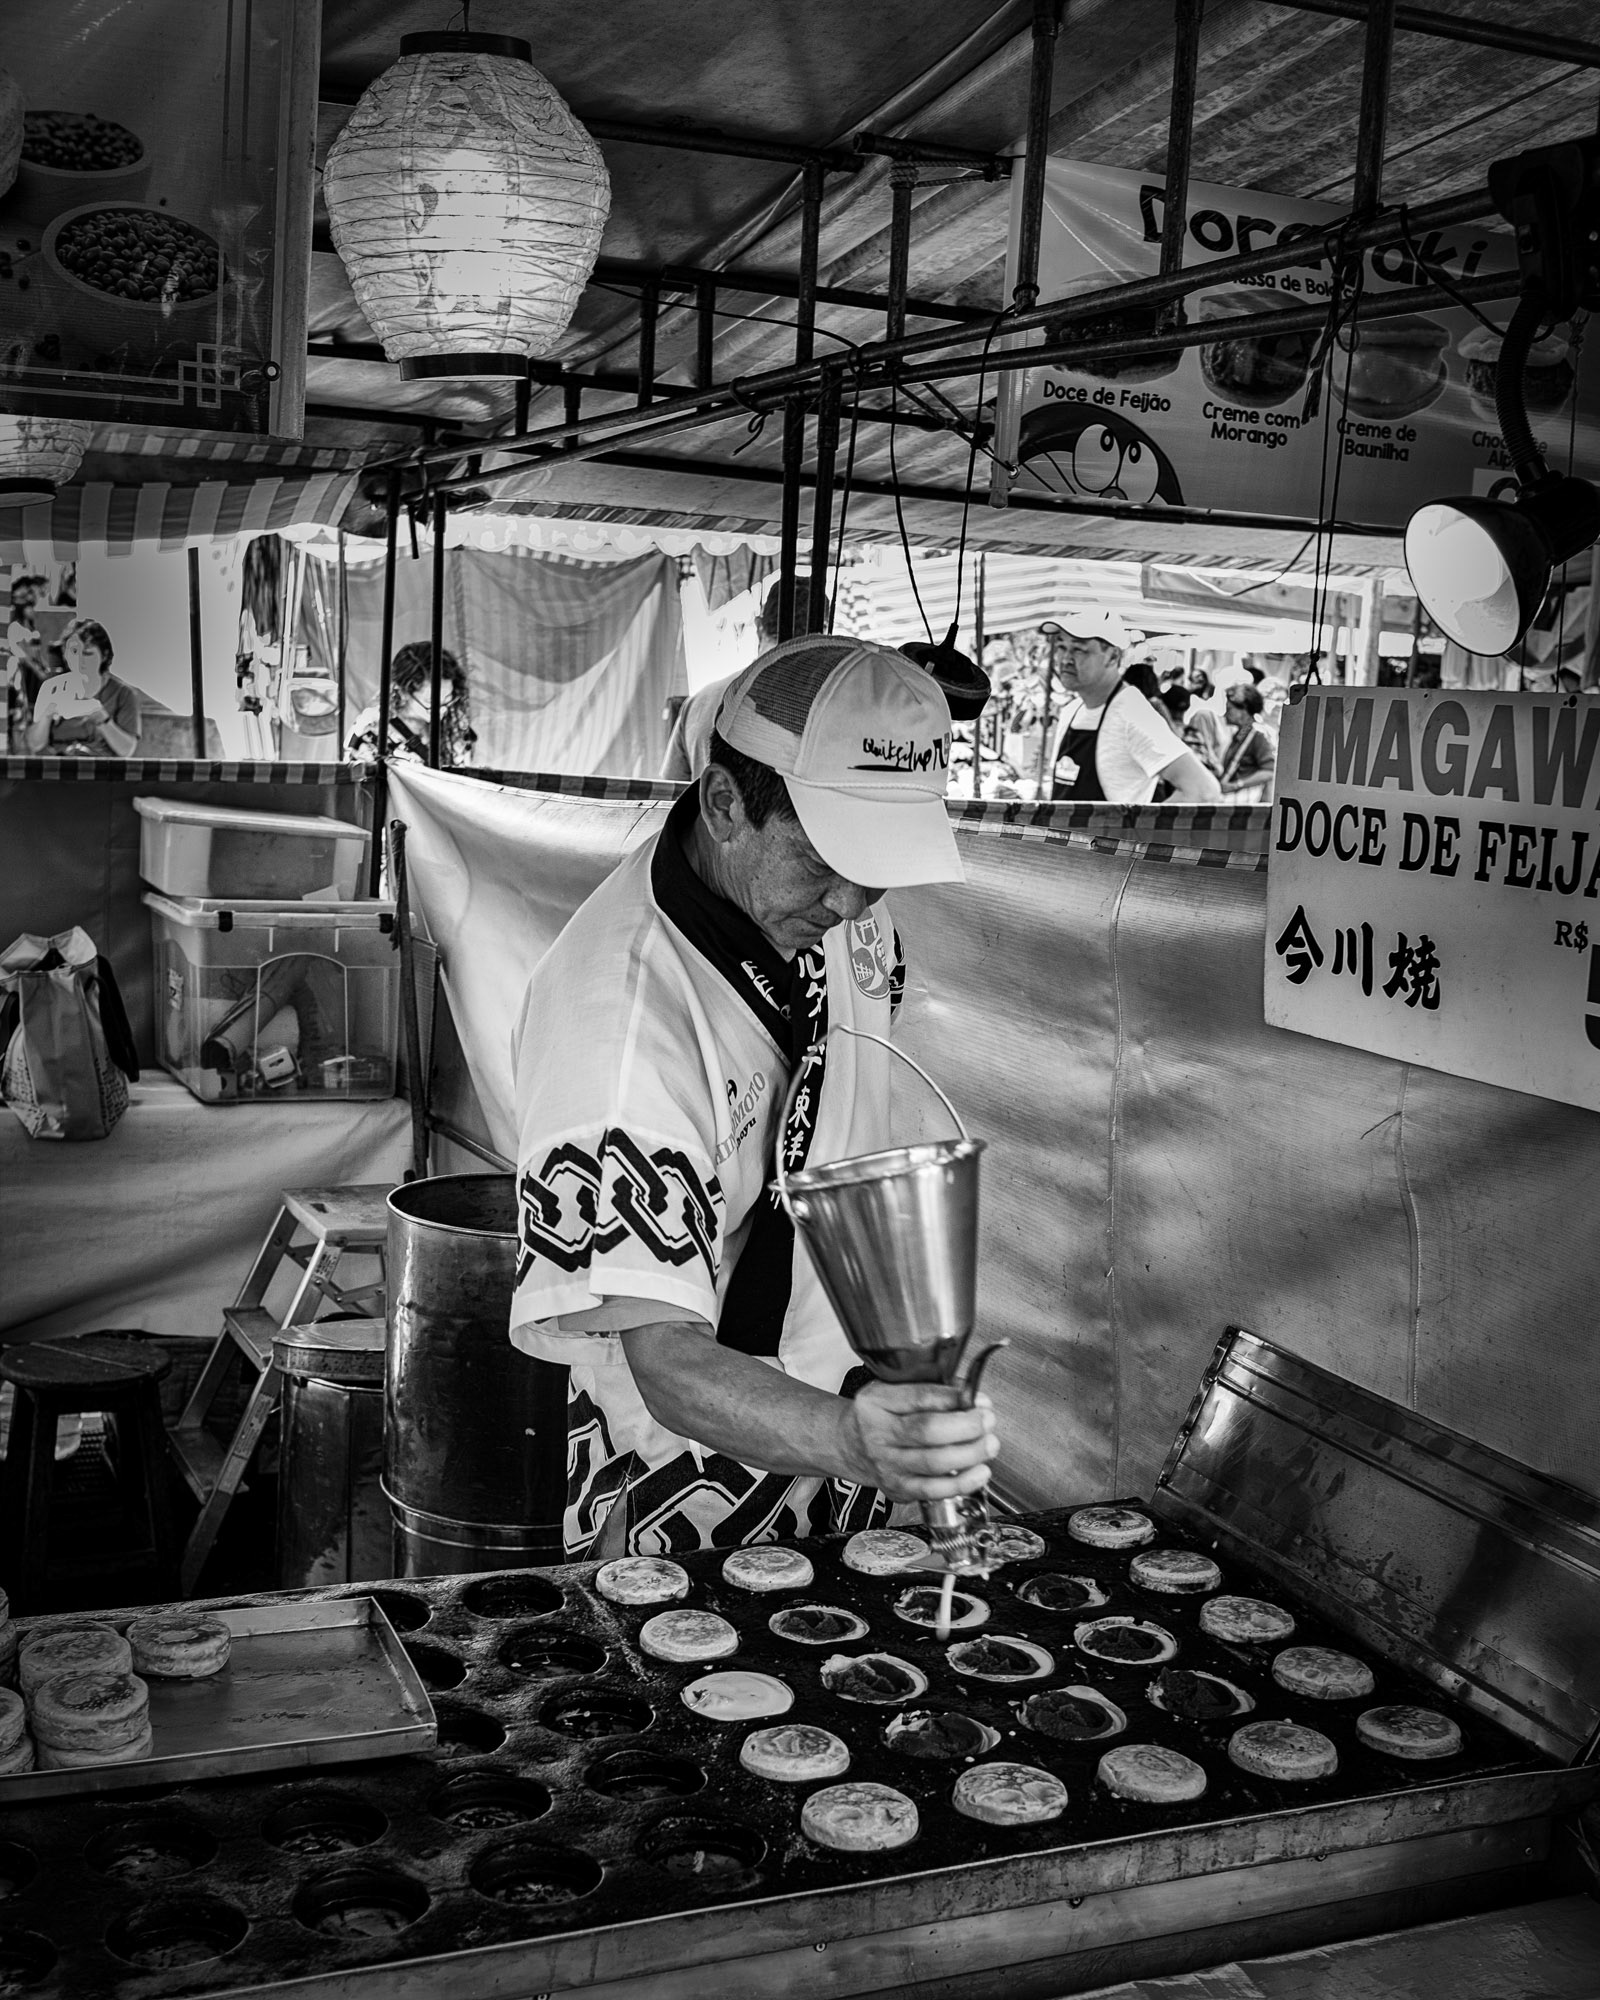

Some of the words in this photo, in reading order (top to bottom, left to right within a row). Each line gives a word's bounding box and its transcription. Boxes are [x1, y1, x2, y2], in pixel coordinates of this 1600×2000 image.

[1281, 275, 1301, 292] de
[1043, 380, 1088, 402] Doce
[1093, 385, 1115, 406] de
[1120, 388, 1172, 413] Feijão
[1202, 401, 1261, 425] Creme
[1265, 408, 1301, 428] com
[1337, 417, 1392, 439] Creme
[1396, 425, 1417, 442] de
[1210, 425, 1288, 448] Morango
[1344, 438, 1409, 462] Baunilha
[1297, 695, 1600, 811] IMAGAW
[1275, 797, 1387, 867] DOCE
[1399, 812, 1461, 878] DE
[1553, 920, 1589, 954] R$
[1275, 904, 1442, 1011] 今川焼
